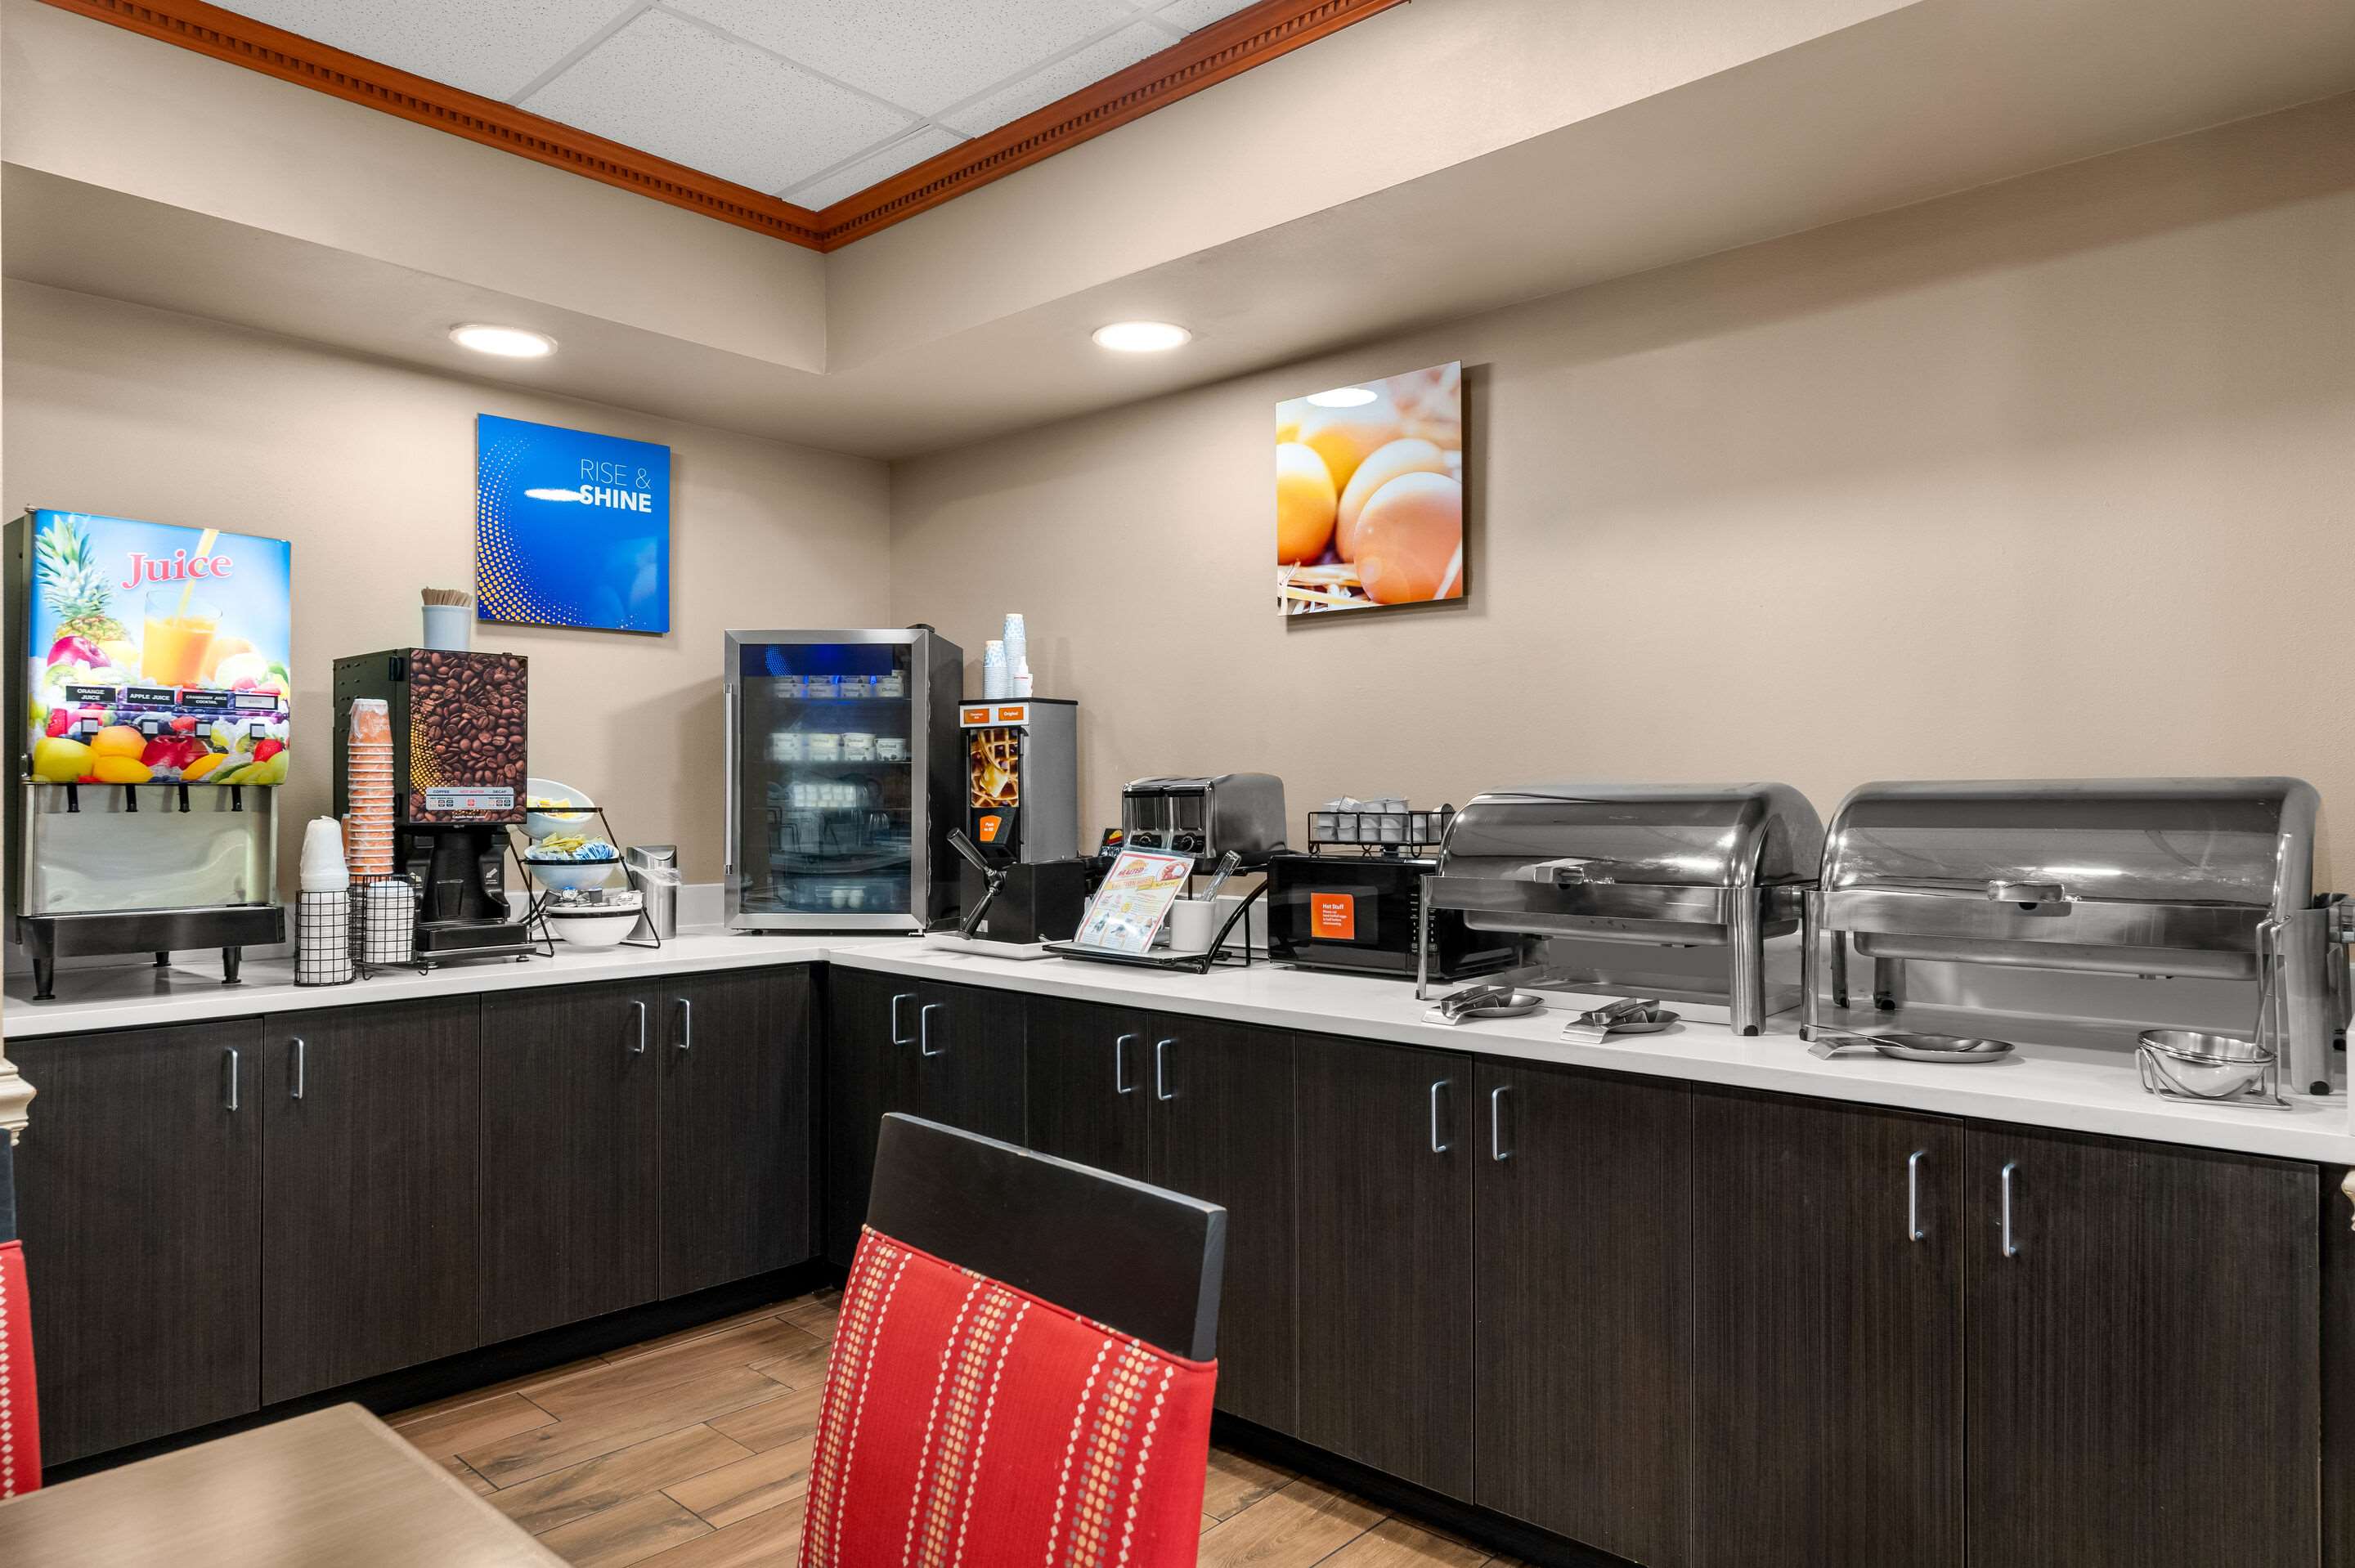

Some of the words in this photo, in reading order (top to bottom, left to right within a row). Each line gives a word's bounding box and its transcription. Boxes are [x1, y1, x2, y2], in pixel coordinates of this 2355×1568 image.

[581, 459, 628, 486] RISE
[635, 468, 651, 490] &
[579, 484, 652, 513] SHINE
[123, 549, 232, 589] Juice
